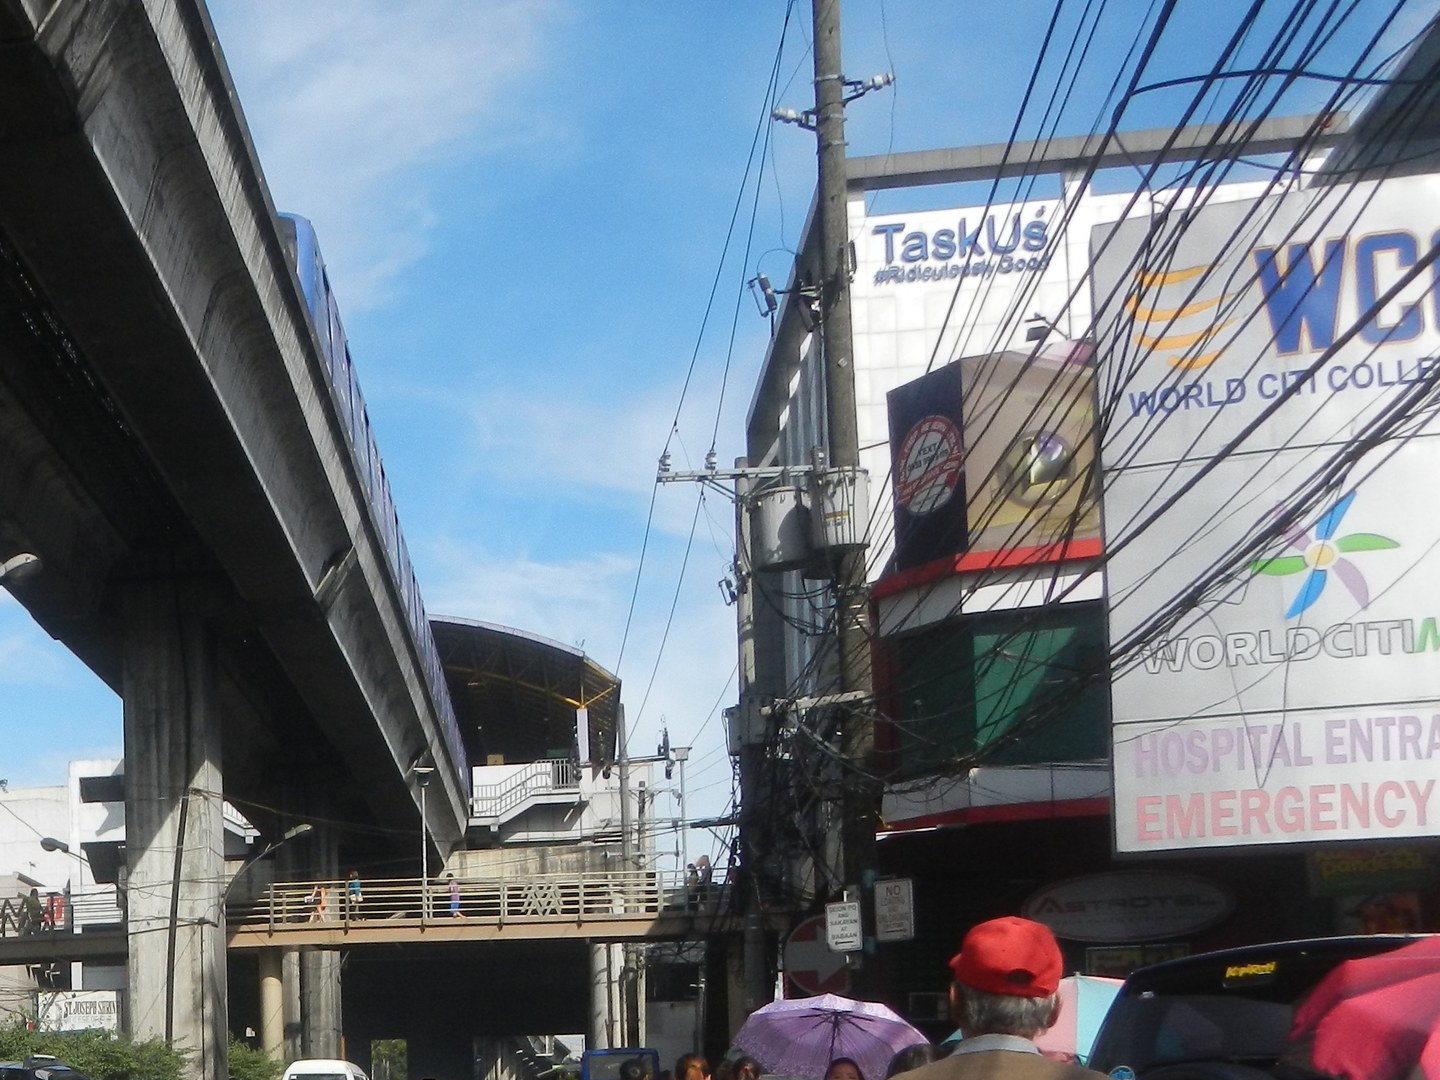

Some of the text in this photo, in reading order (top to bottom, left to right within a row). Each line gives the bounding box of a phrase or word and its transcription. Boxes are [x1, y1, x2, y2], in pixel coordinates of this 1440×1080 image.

[1252, 229, 1440, 359] WC
[1128, 377, 1247, 419] WORLD
[1257, 368, 1317, 400] CITI
[1134, 721, 1314, 779] HOSPITAL
[1135, 779, 1437, 842] EMERGENCY
[885, 884, 901, 897] NO
